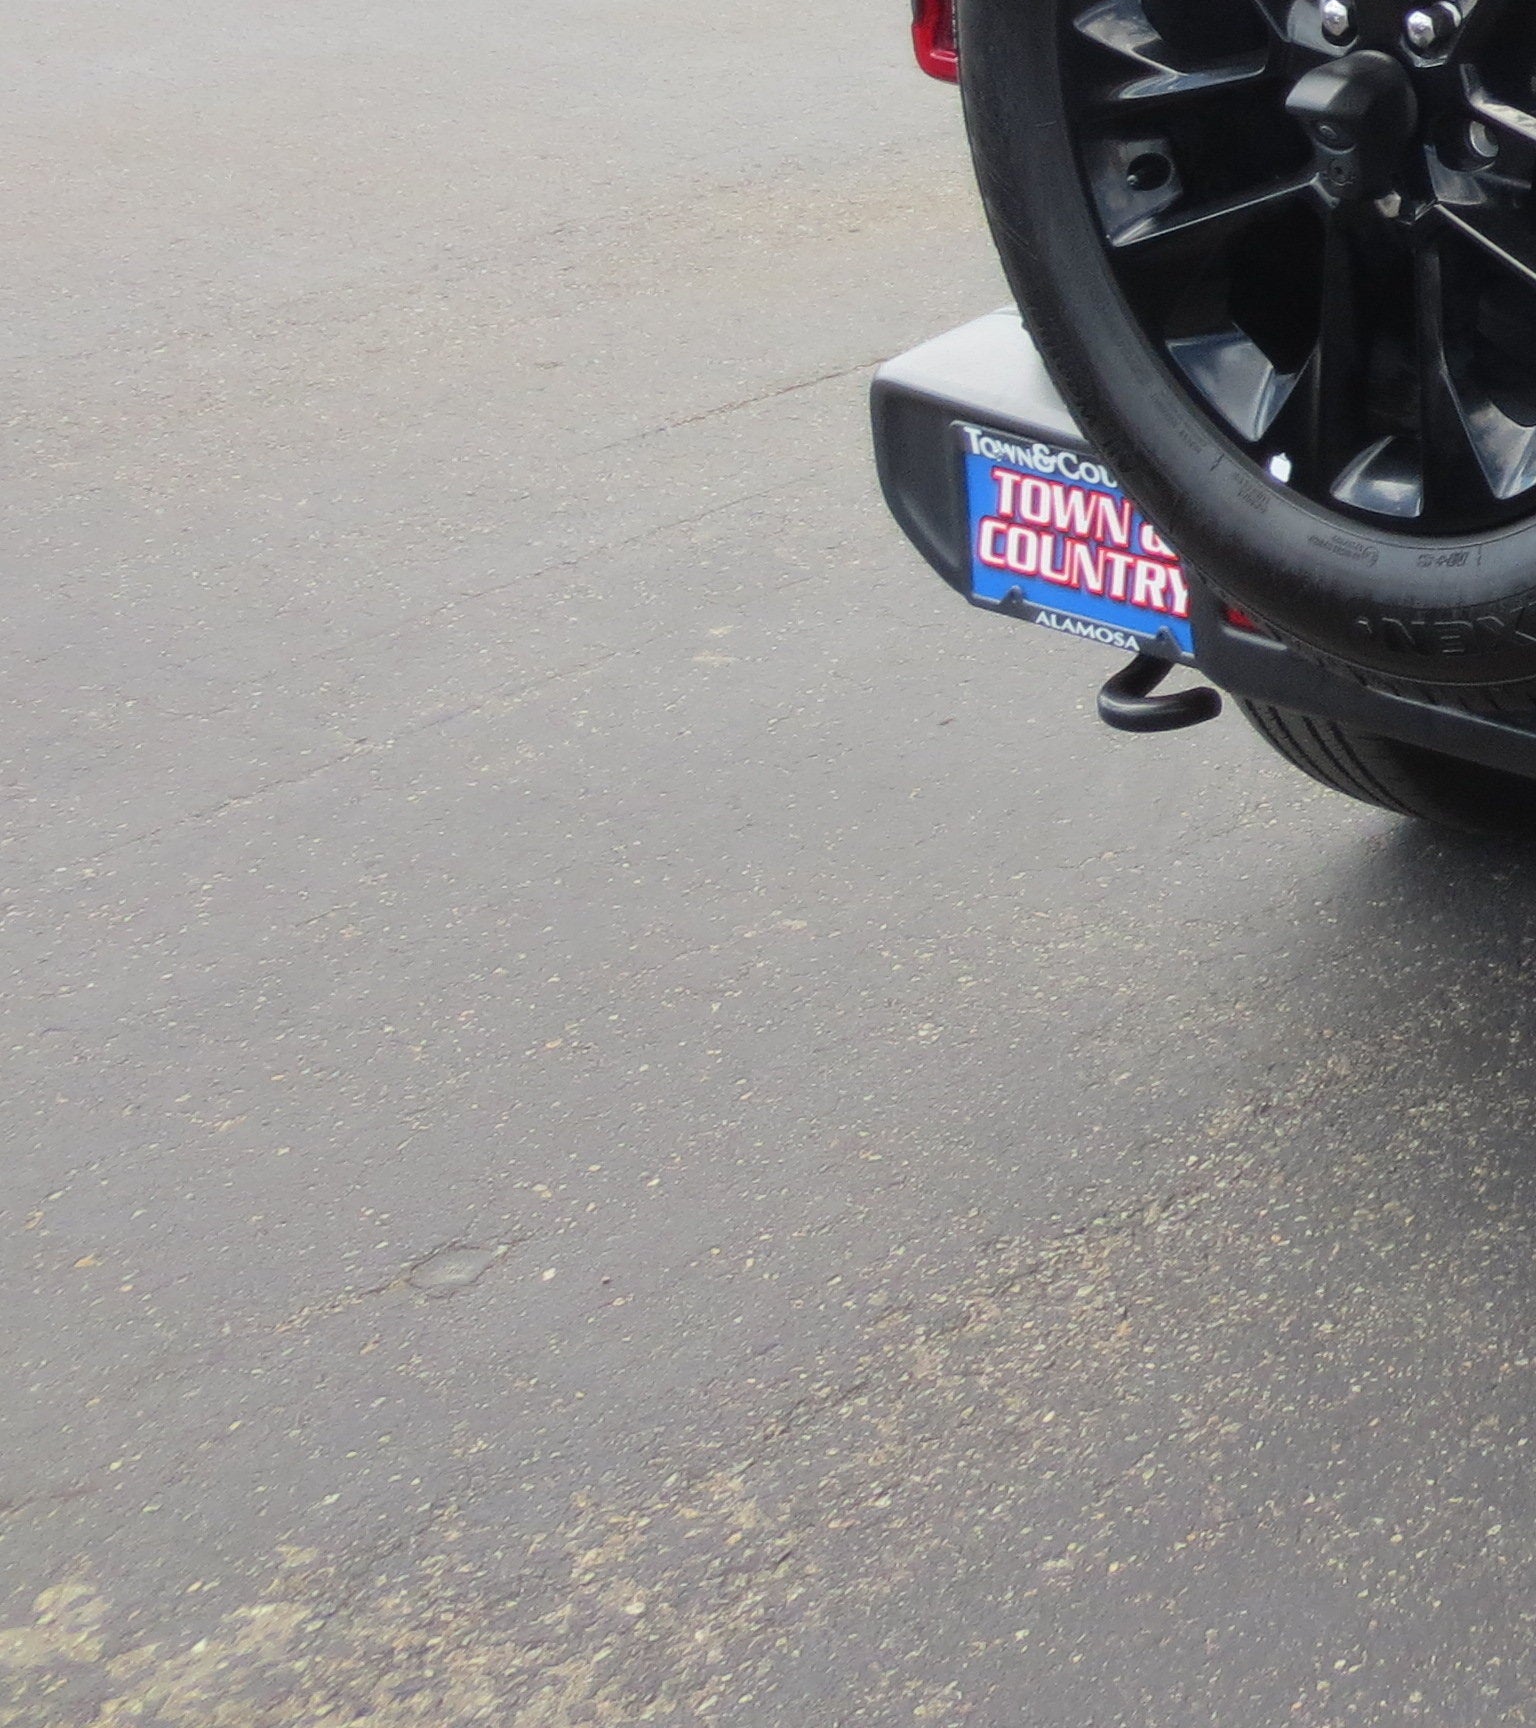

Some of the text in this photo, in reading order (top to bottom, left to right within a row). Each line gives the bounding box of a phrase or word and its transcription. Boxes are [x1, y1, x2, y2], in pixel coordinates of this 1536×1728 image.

[991, 467, 1133, 549] TOWN
[979, 516, 1191, 618] COUNTRY
[1035, 610, 1141, 653] ALAMOSA
